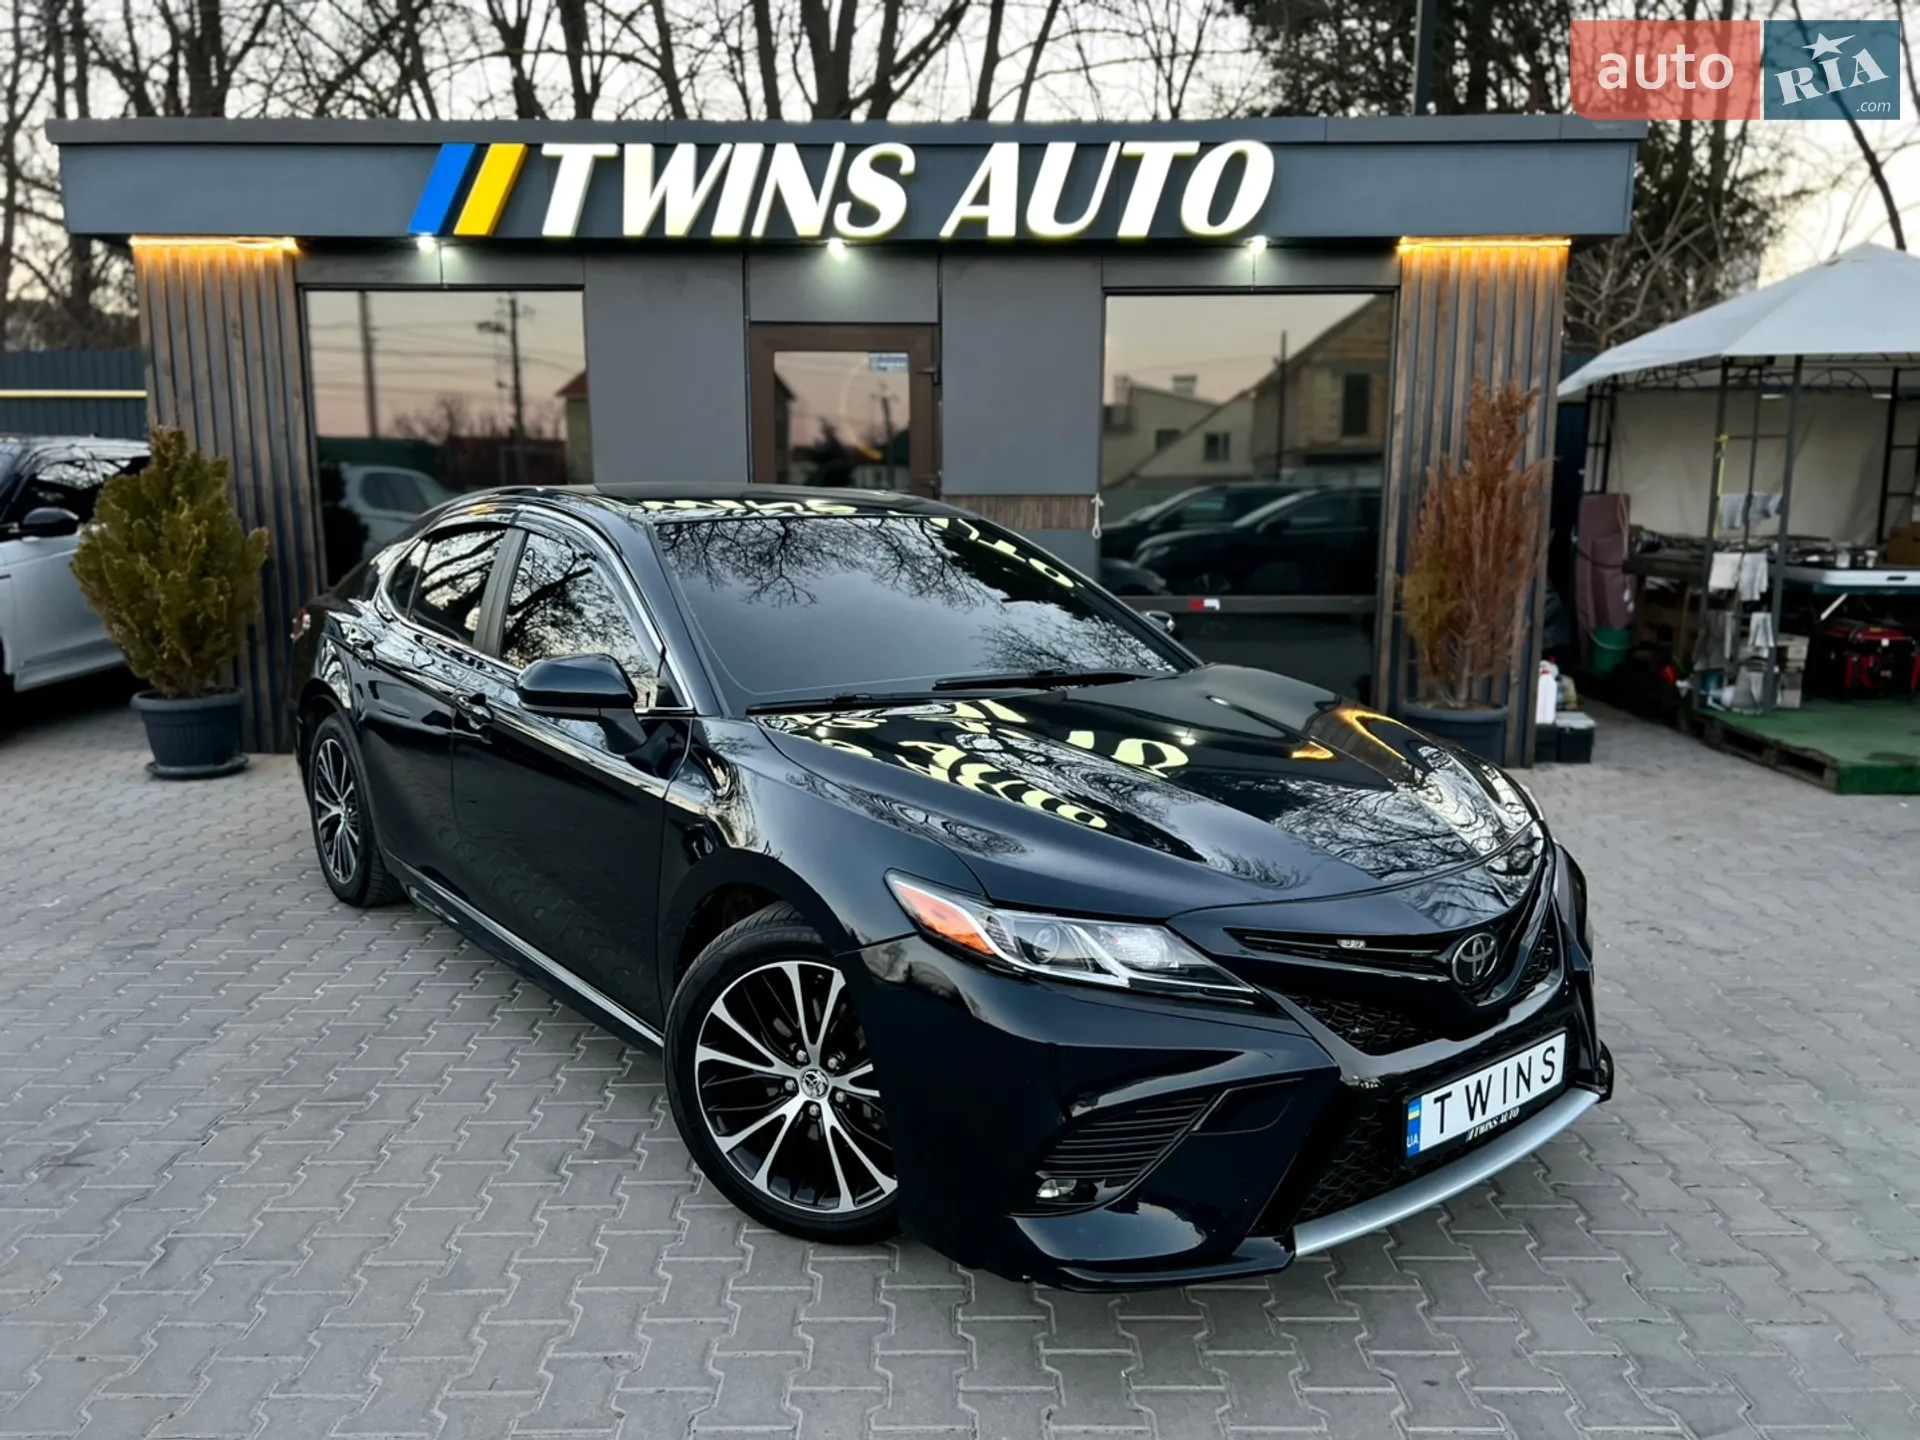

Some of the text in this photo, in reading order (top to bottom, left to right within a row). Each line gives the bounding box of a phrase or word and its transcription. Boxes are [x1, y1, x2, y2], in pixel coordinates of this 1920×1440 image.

[540, 139, 1277, 239] TWINS AUTO
[1407, 1133, 1419, 1148] UA
